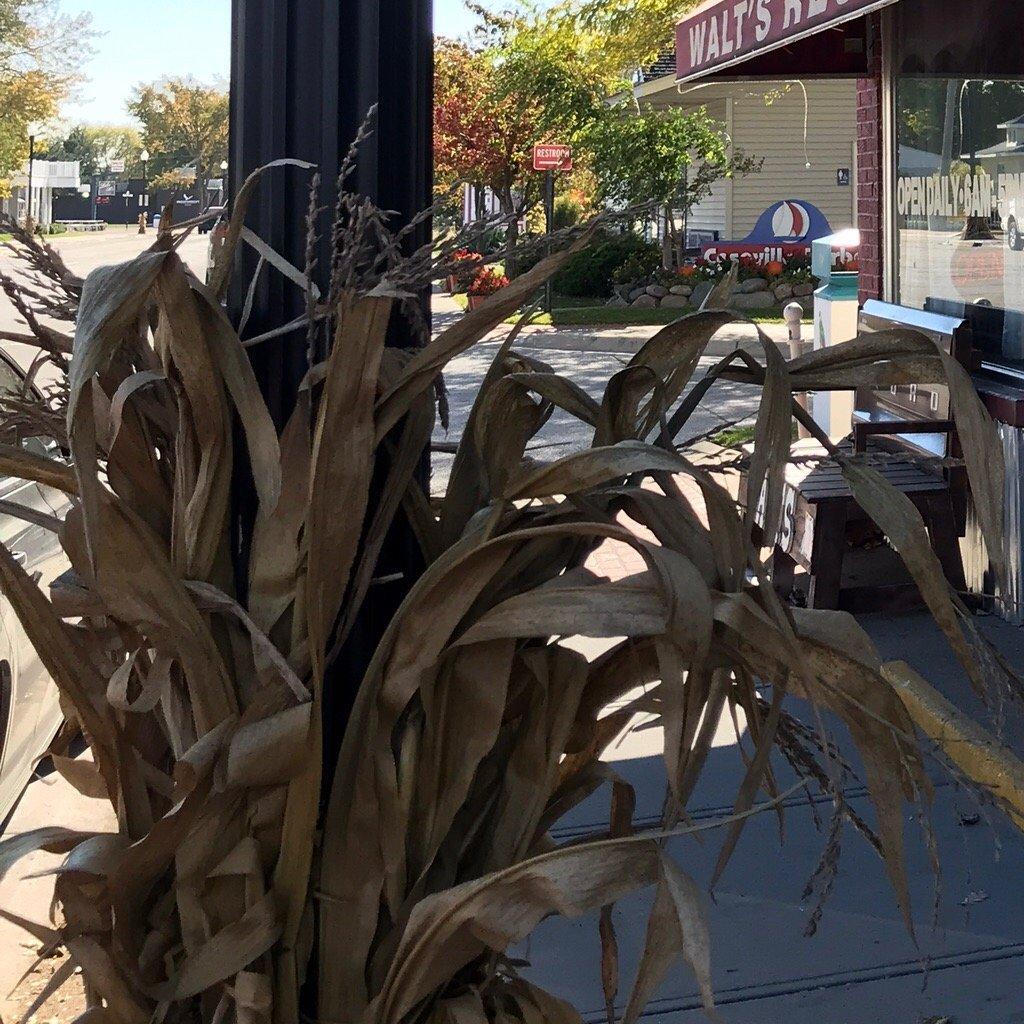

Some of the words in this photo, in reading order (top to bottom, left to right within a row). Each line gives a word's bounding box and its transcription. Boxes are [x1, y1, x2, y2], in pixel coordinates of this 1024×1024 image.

[897, 176, 926, 216] OPEN
[926, 175, 961, 216] DAILY
[704, 246, 793, 267] Casevill
